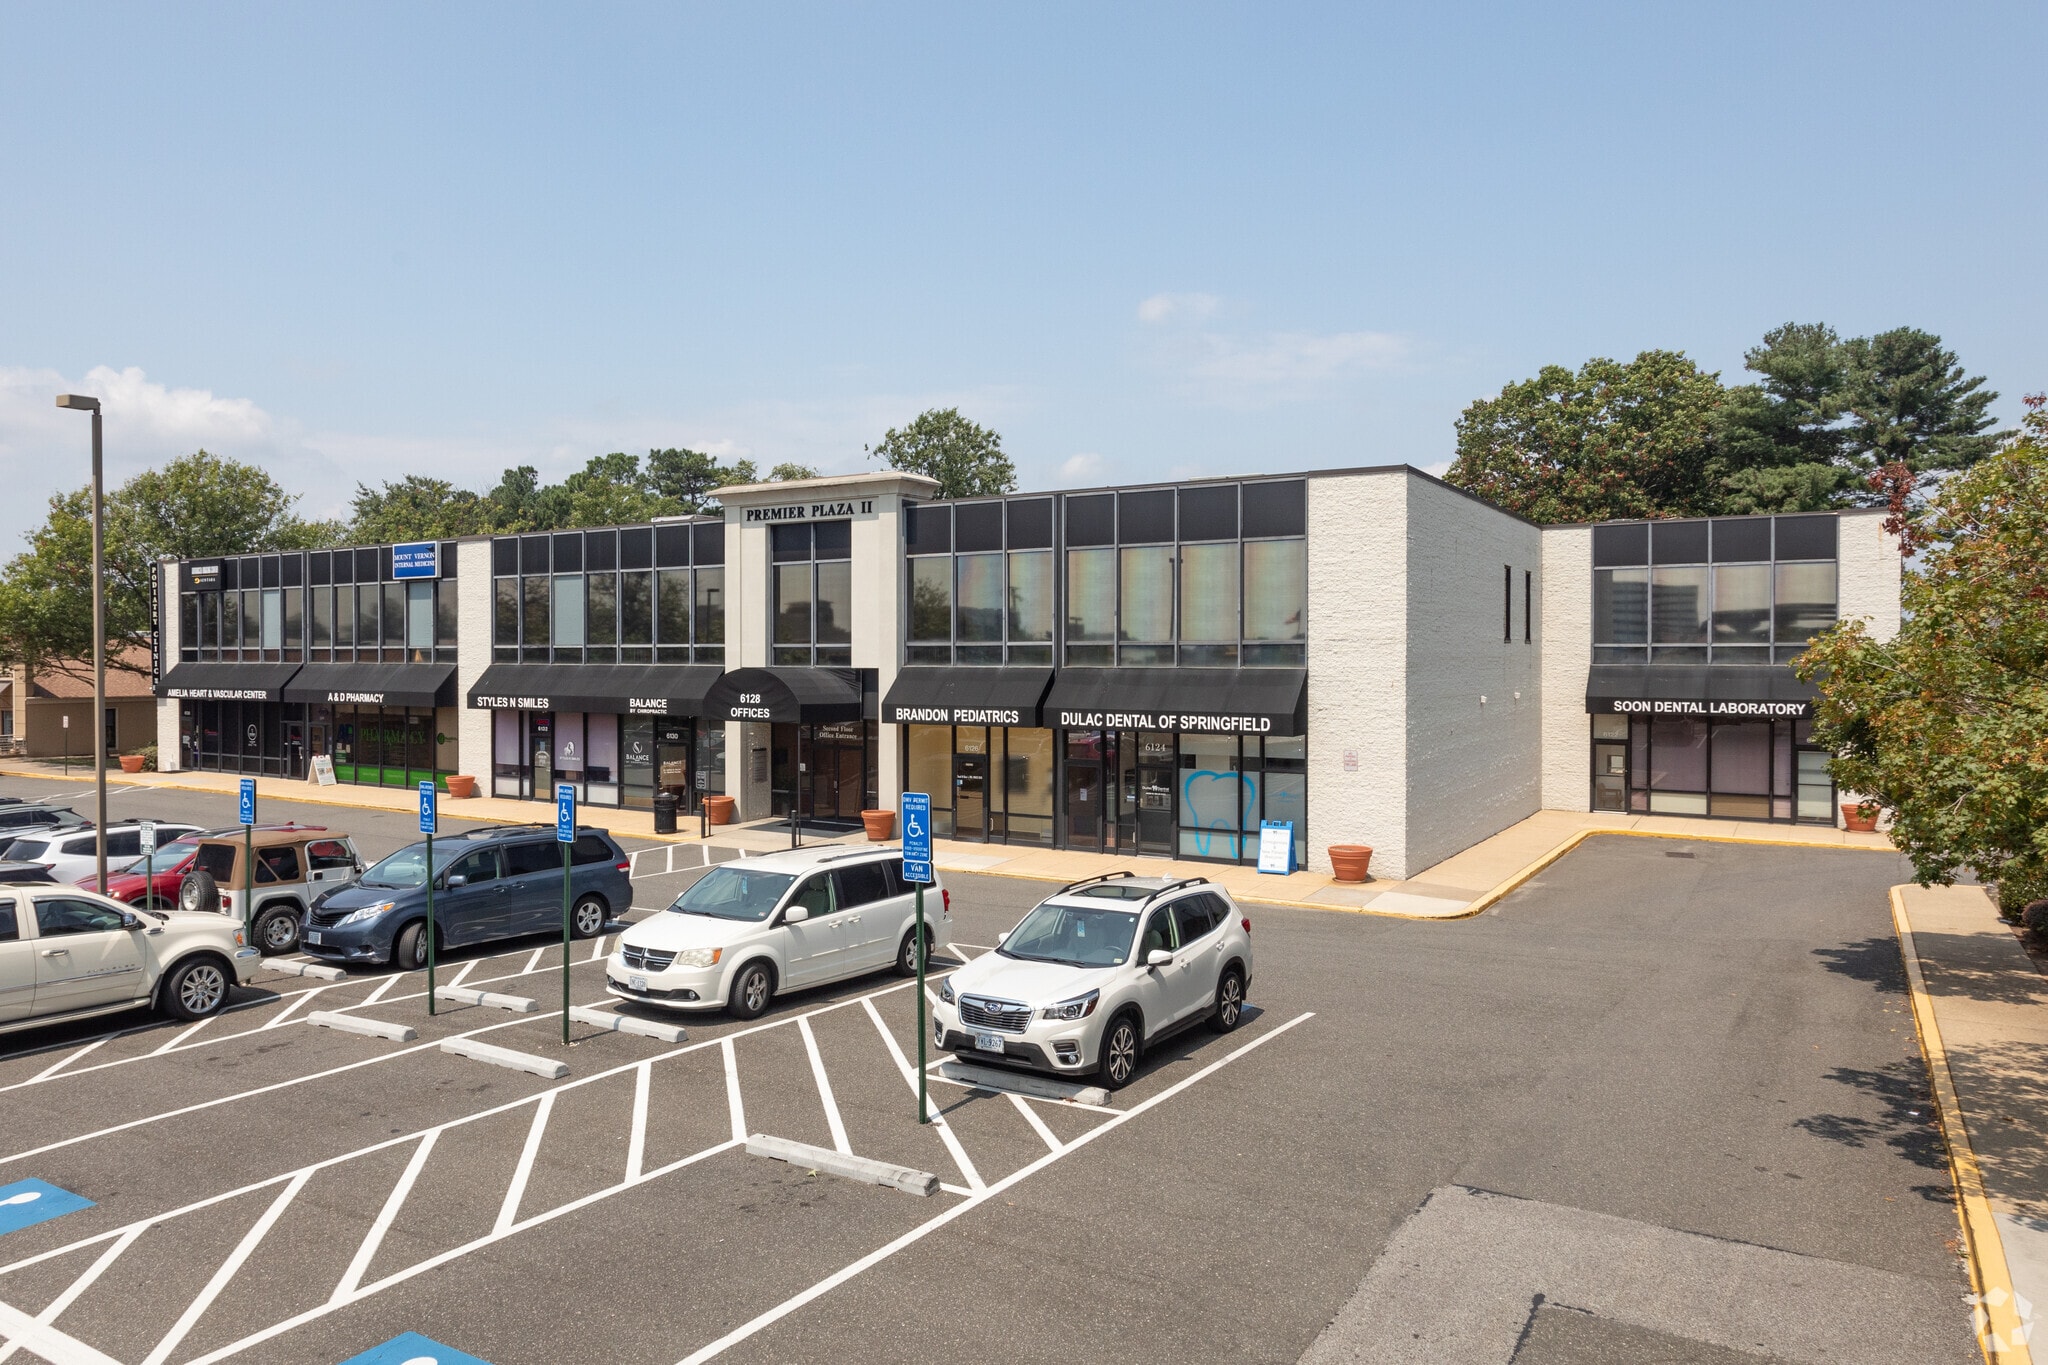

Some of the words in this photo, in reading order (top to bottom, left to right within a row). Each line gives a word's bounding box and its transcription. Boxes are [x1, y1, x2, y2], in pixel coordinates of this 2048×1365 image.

[746, 506, 805, 521] PREMIER
[811, 502, 855, 517] PLAZA
[861, 500, 873, 514] II
[394, 553, 412, 561] MOUNT
[413, 552, 435, 560] VERNON
[167, 688, 189, 698] AMELIA
[189, 689, 207, 698] HEART
[207, 690, 212, 698] &
[212, 689, 243, 699] VASCULAR
[243, 690, 267, 699] CENTER
[327, 692, 333, 701] A
[334, 693, 339, 701] &
[340, 693, 345, 701] D
[346, 693, 384, 703] PHARMACY
[740, 693, 761, 704] 6128
[477, 696, 508, 708] STYLES
[509, 697, 516, 708] N
[517, 697, 549, 709] SMILES
[629, 698, 667, 708] BALANCE
[1613, 700, 1651, 712] SOON
[1654, 701, 1707, 714] DENTAL
[1710, 702, 1806, 715] LABORATORY
[730, 707, 770, 718] OFFICES
[895, 708, 948, 721] BRANDON
[953, 709, 1019, 723] PEDIATRICS
[1061, 711, 1103, 726] DULAC
[1105, 713, 1156, 728] DENTAL
[1158, 715, 1177, 729] OF
[1180, 715, 1271, 732] SPRINGFIELD
[666, 732, 679, 740] 6130
[819, 731, 834, 739] Office
[836, 732, 857, 740] Entrance
[964, 744, 979, 752] 6126
[1145, 743, 1166, 752] 6124
[910, 863, 923, 873] VAN
